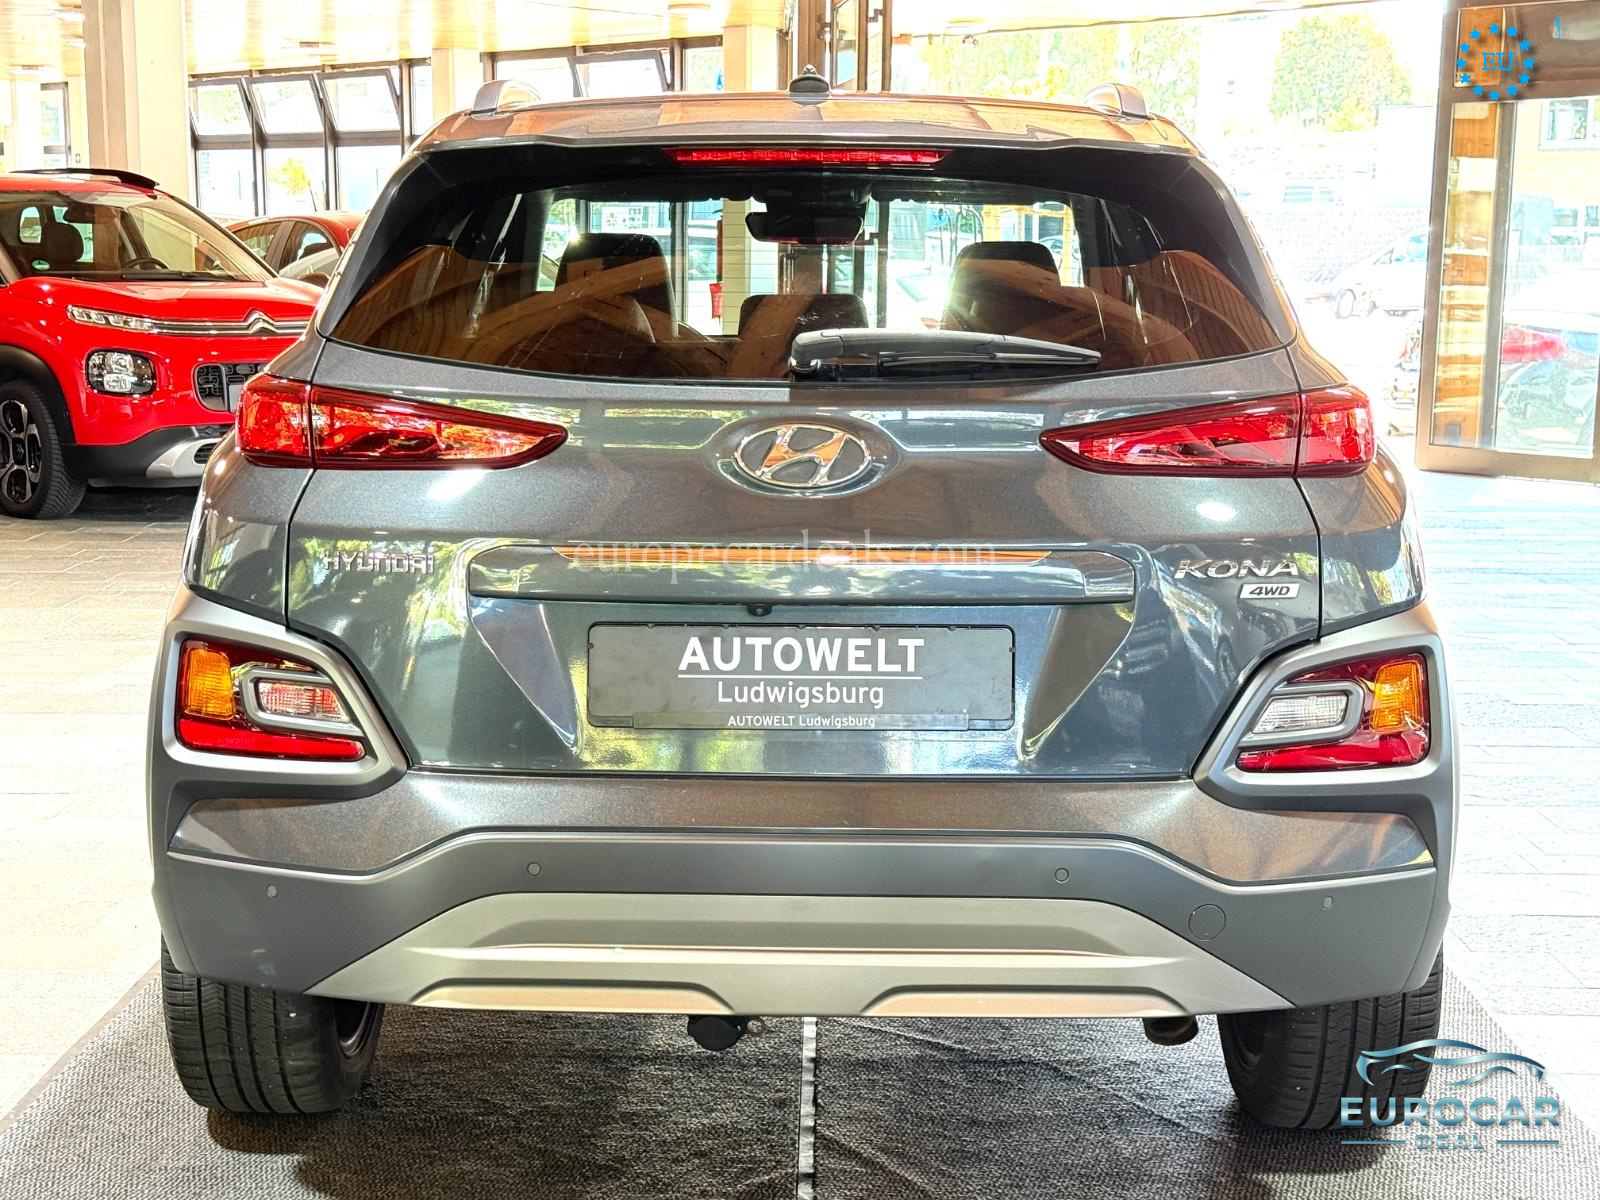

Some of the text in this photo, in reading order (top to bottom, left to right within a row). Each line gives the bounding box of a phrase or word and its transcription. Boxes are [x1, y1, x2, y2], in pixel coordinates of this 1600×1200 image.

[320, 549, 435, 574] HYUNDAI
[1173, 559, 1299, 579] KONA
[1249, 586, 1290, 596] 4WD
[678, 636, 925, 673] AUTOWELT
[717, 680, 884, 709] Ludwigsburg
[727, 714, 877, 729] AUTOWELT Ludwigsburg
